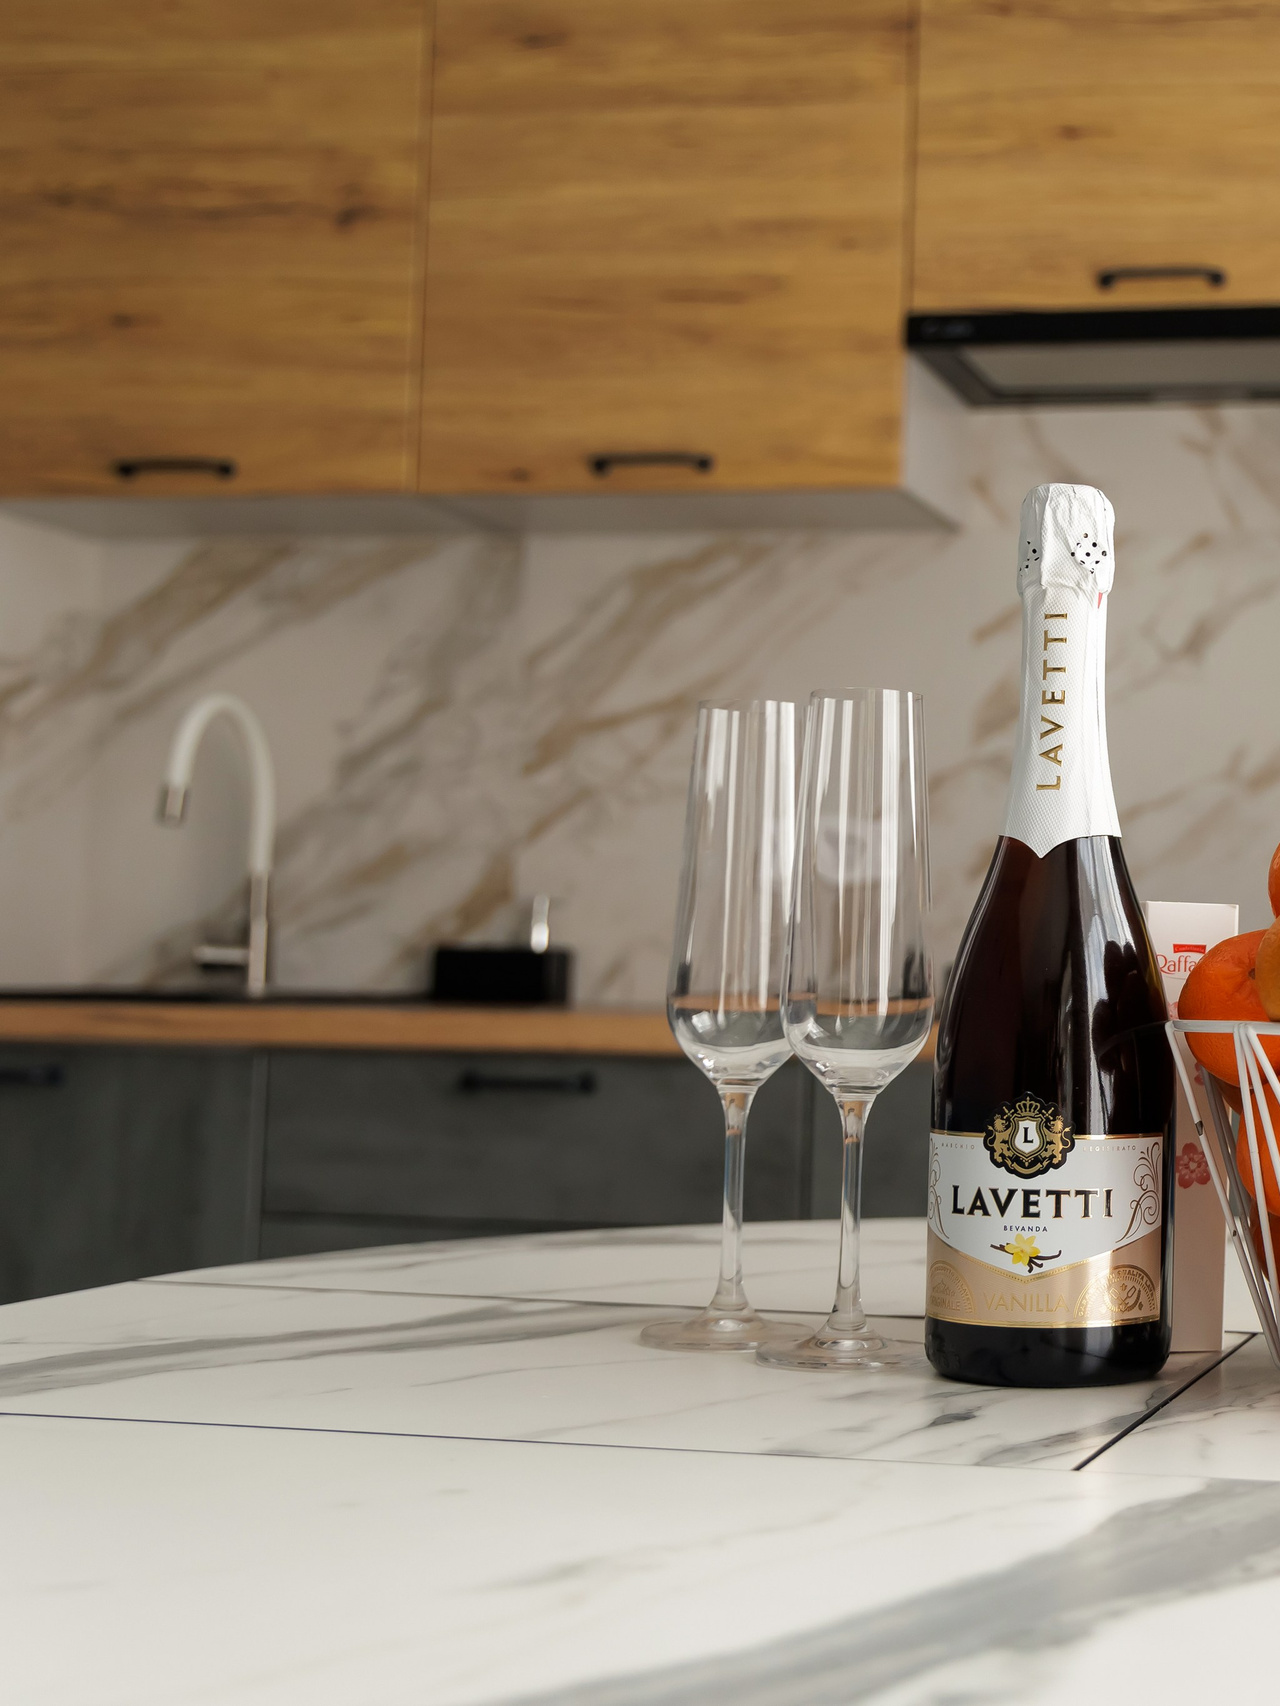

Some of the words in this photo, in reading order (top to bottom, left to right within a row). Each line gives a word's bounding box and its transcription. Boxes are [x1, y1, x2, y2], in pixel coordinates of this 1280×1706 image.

[1036, 613, 1068, 791] LAVETTI
[1023, 1127, 1034, 1144] L
[951, 1184, 1114, 1219] LAVETTI
[983, 1292, 1070, 1313] VANILLA
